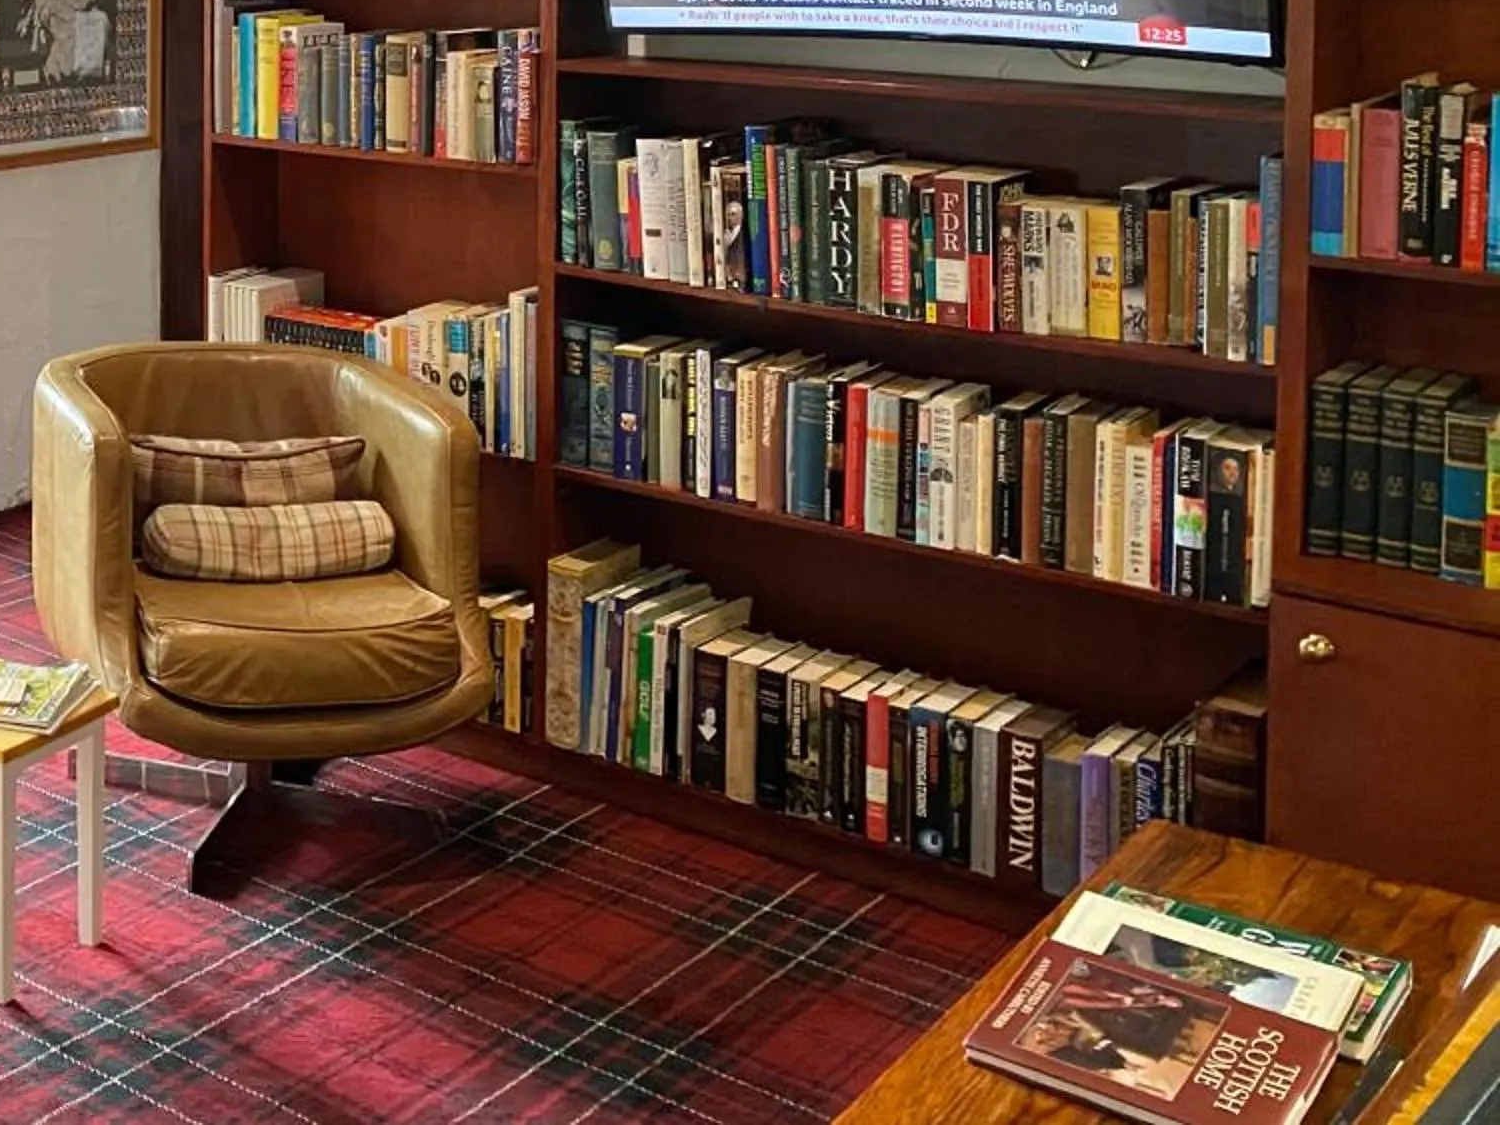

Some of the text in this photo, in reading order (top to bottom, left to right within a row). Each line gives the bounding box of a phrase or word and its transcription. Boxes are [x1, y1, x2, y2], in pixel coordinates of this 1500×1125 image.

[1038, 0, 1051, 12] in
[1056, 0, 1119, 16] England
[1142, 26, 1182, 42] 12:25
[501, 46, 513, 95] CAINE
[518, 58, 532, 120] DAVID JASON
[1402, 118, 1421, 212] JULES VERNE
[827, 168, 854, 296] HARDY
[940, 193, 960, 252] FDR
[1024, 211, 1036, 252] MARKS
[890, 222, 905, 294] WASHINGTON
[1002, 245, 1017, 322] SHE-WOLVES
[934, 407, 952, 453] GRANT
[639, 679, 650, 721] GOLF
[915, 726, 928, 818] INTERROGATIONS
[1008, 734, 1038, 873] BALDWIN
[1193, 1031, 1248, 1090] HOME
[1213, 1026, 1285, 1116] SCOTTISH
[1258, 1063, 1302, 1102] THE
